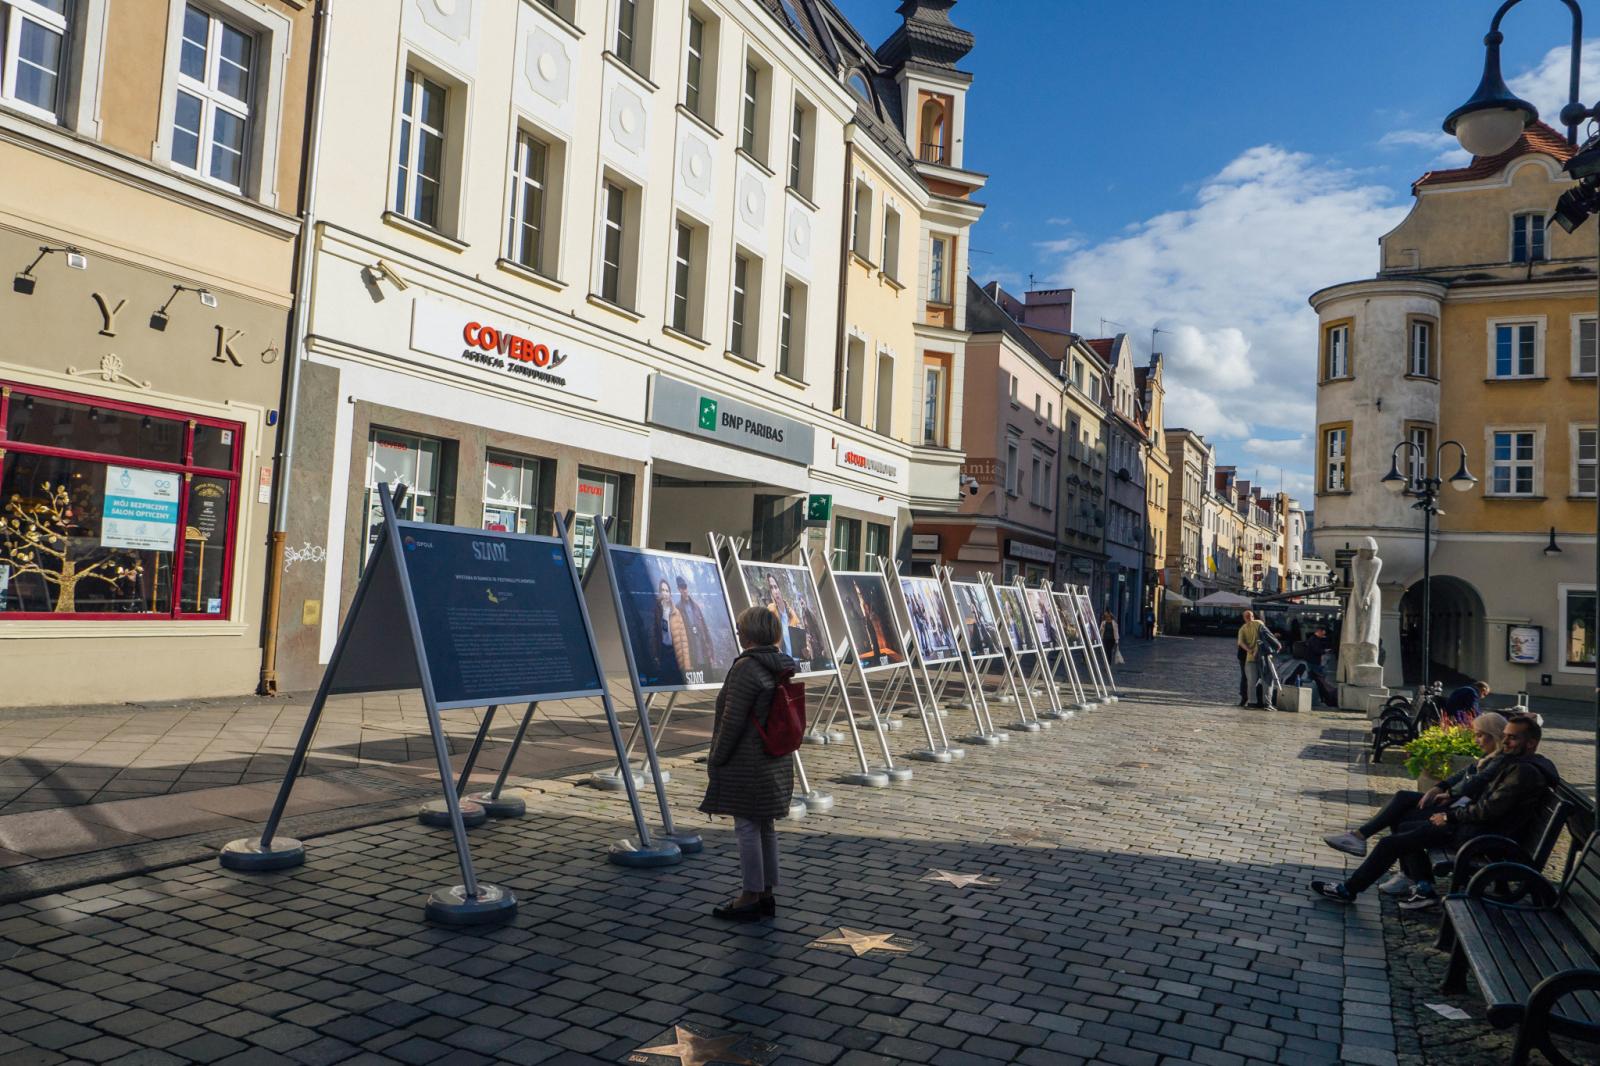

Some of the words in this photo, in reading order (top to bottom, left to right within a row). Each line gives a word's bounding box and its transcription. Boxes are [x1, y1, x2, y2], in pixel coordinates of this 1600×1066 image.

[463, 321, 550, 367] COVEBO
[721, 411, 744, 431] BNP
[745, 419, 785, 443] PARIBAS
